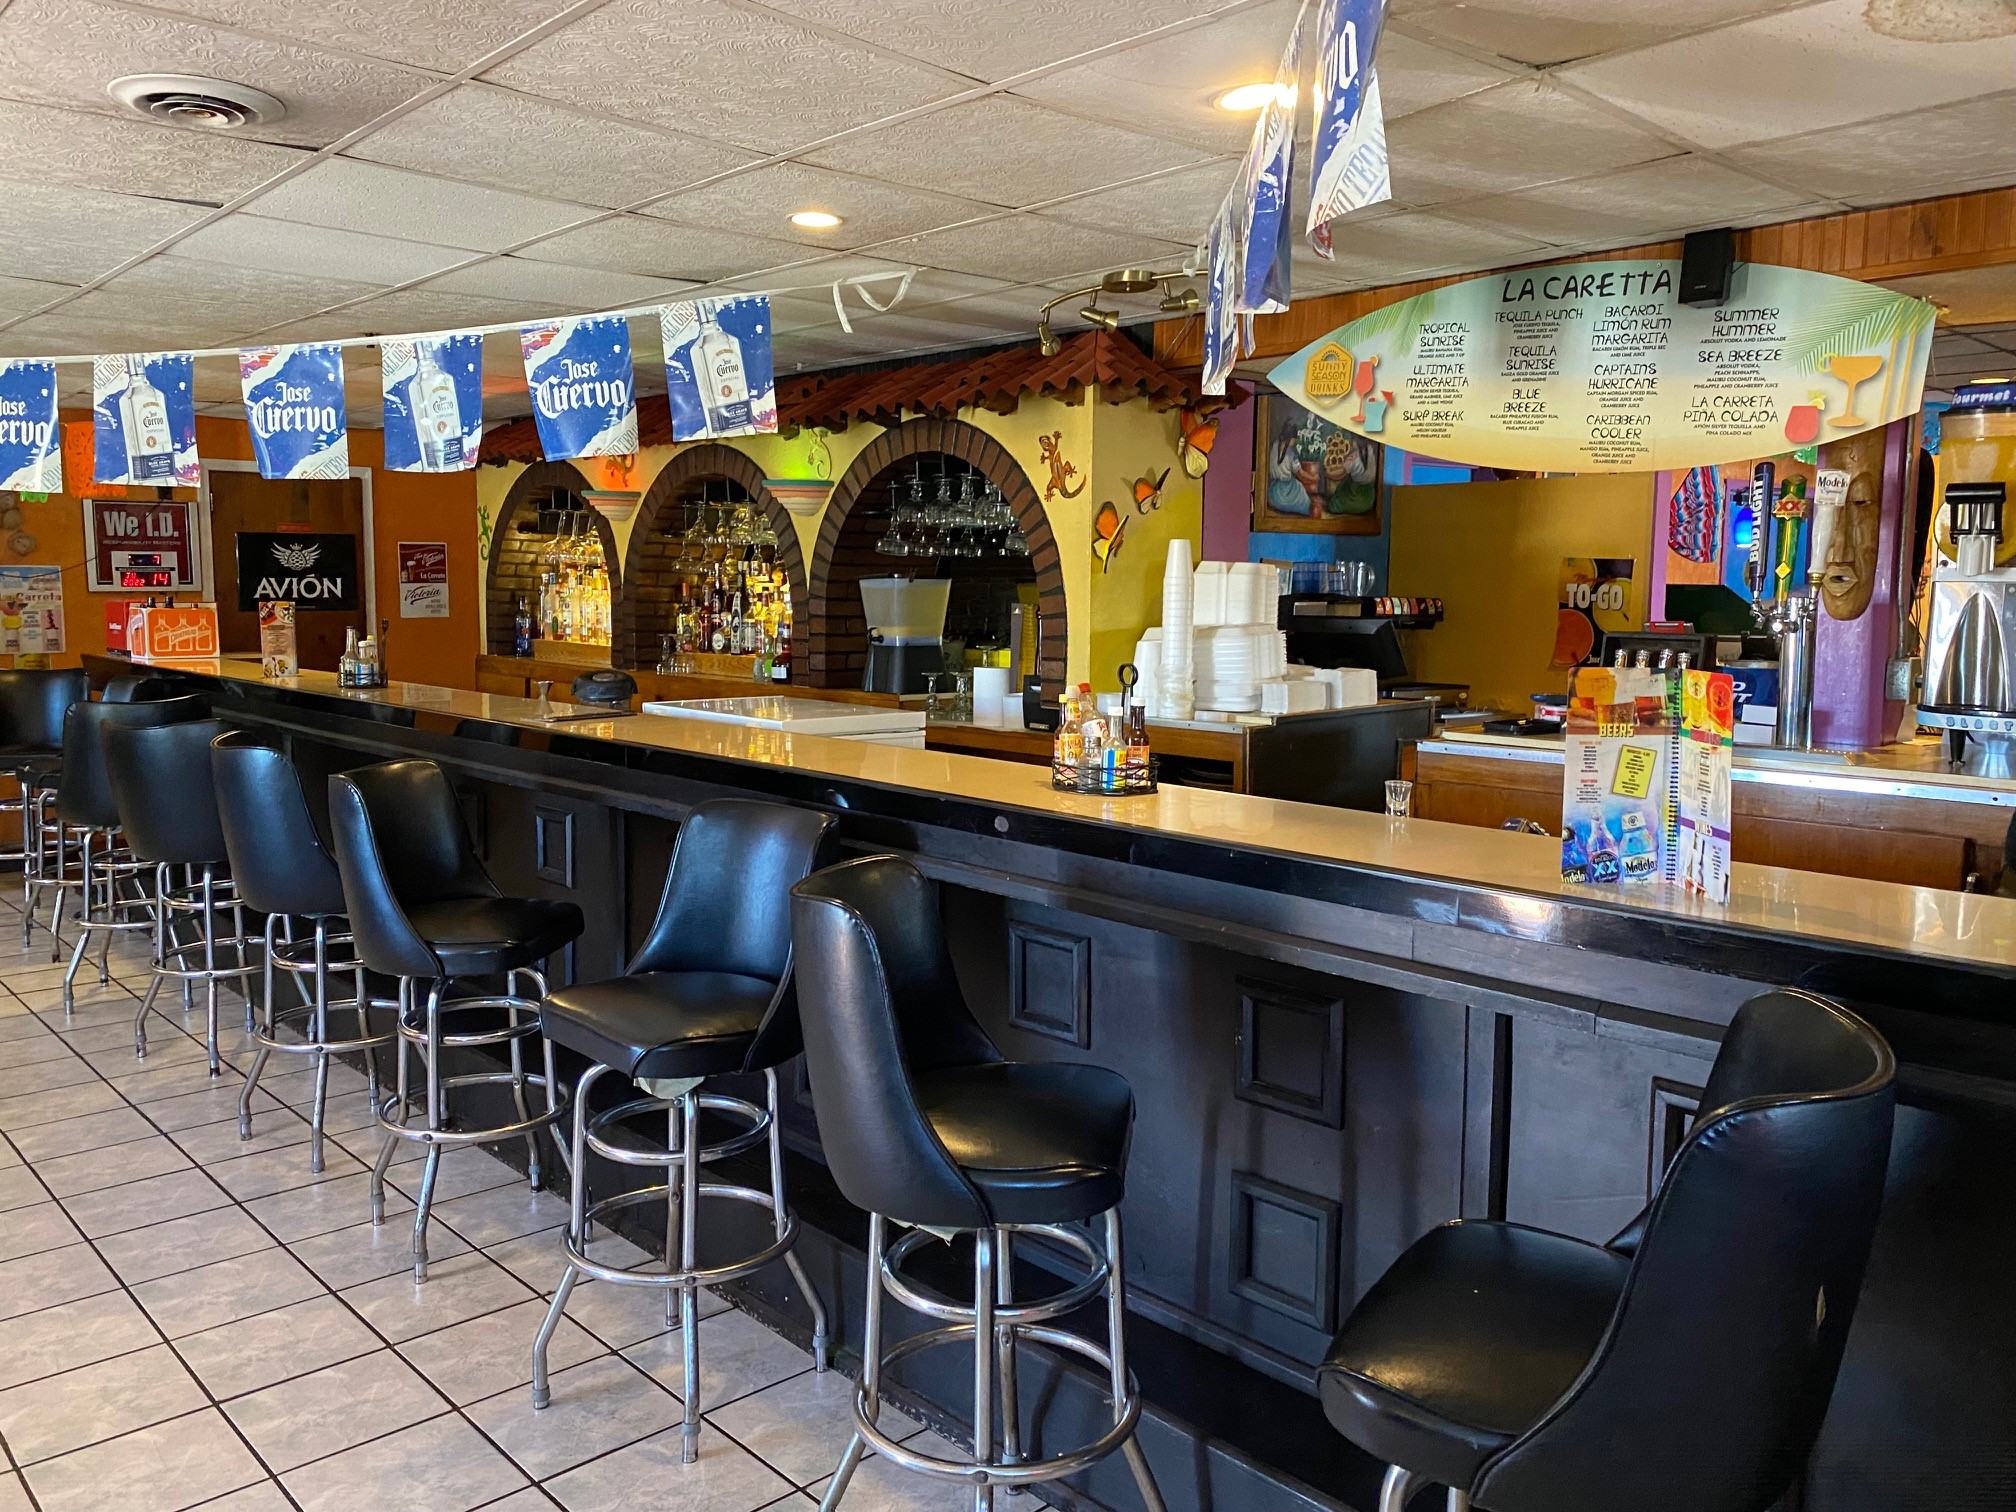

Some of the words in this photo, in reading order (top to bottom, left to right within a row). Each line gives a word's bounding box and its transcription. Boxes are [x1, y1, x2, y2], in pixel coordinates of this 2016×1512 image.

[1502, 278, 1535, 302] LA
[1543, 269, 1671, 300] CARETTA
[1495, 310, 1542, 323] TEQUILA
[1545, 308, 1583, 320] PUNCH
[1604, 303, 1664, 318] BACARDI
[1714, 307, 1780, 322] SUMMER
[1419, 322, 1470, 334] TROPICAL
[1593, 317, 1638, 332] LIMÓN
[1641, 317, 1672, 330] RUM
[1712, 322, 1776, 337] HUMMER
[1420, 335, 1466, 347] SUNRISE
[1592, 332, 1668, 345] MARGARITA
[1509, 345, 1557, 358] TEQUILA
[1698, 350, 1724, 363] SEA
[1728, 349, 1783, 362] BREEZE
[1312, 361, 1348, 372] SUNNY
[1413, 364, 1466, 375] ULTIMATE
[1506, 358, 1557, 371] SUNRISE
[1594, 363, 1657, 376] CAPTAINS
[560, 359, 598, 384] Jose
[1311, 372, 1347, 381] SEASON
[1310, 383, 1345, 393] DRINKS
[1406, 377, 1469, 388] MARGARITA
[1589, 377, 1660, 390] HURRICANE
[276, 382, 311, 406] Jose
[536, 375, 627, 419] Cuervo
[1512, 388, 1541, 400] BLUE
[0, 396, 26, 416] ose
[1503, 401, 1547, 413] BREEZE
[1692, 396, 1708, 408] LA
[1713, 395, 1774, 408] CARRETA
[252, 396, 336, 439] Cuervo
[1403, 410, 1430, 421] SURF
[1432, 411, 1464, 421] BREAK
[1586, 414, 1651, 426] CARIBBEAN
[1721, 410, 1779, 422] COLADA
[0, 419, 49, 446] ervo
[1591, 427, 1642, 439] COOLER
[1818, 476, 1848, 488] Modelo
[1752, 480, 1764, 526] LIGHT
[103, 511, 139, 537] We
[145, 510, 179, 538] I.D.
[1749, 528, 1760, 563] BUD
[153, 555, 160, 565] 7
[153, 573, 169, 586] 14
[253, 573, 342, 599] AVIÓN
[405, 584, 441, 605] Victoria
[1566, 583, 1623, 610] TO-GO
[1600, 723, 1634, 737] BEERS
[1946, 716, 2014, 732] BLAST
[1625, 858, 1654, 874] Modelo
